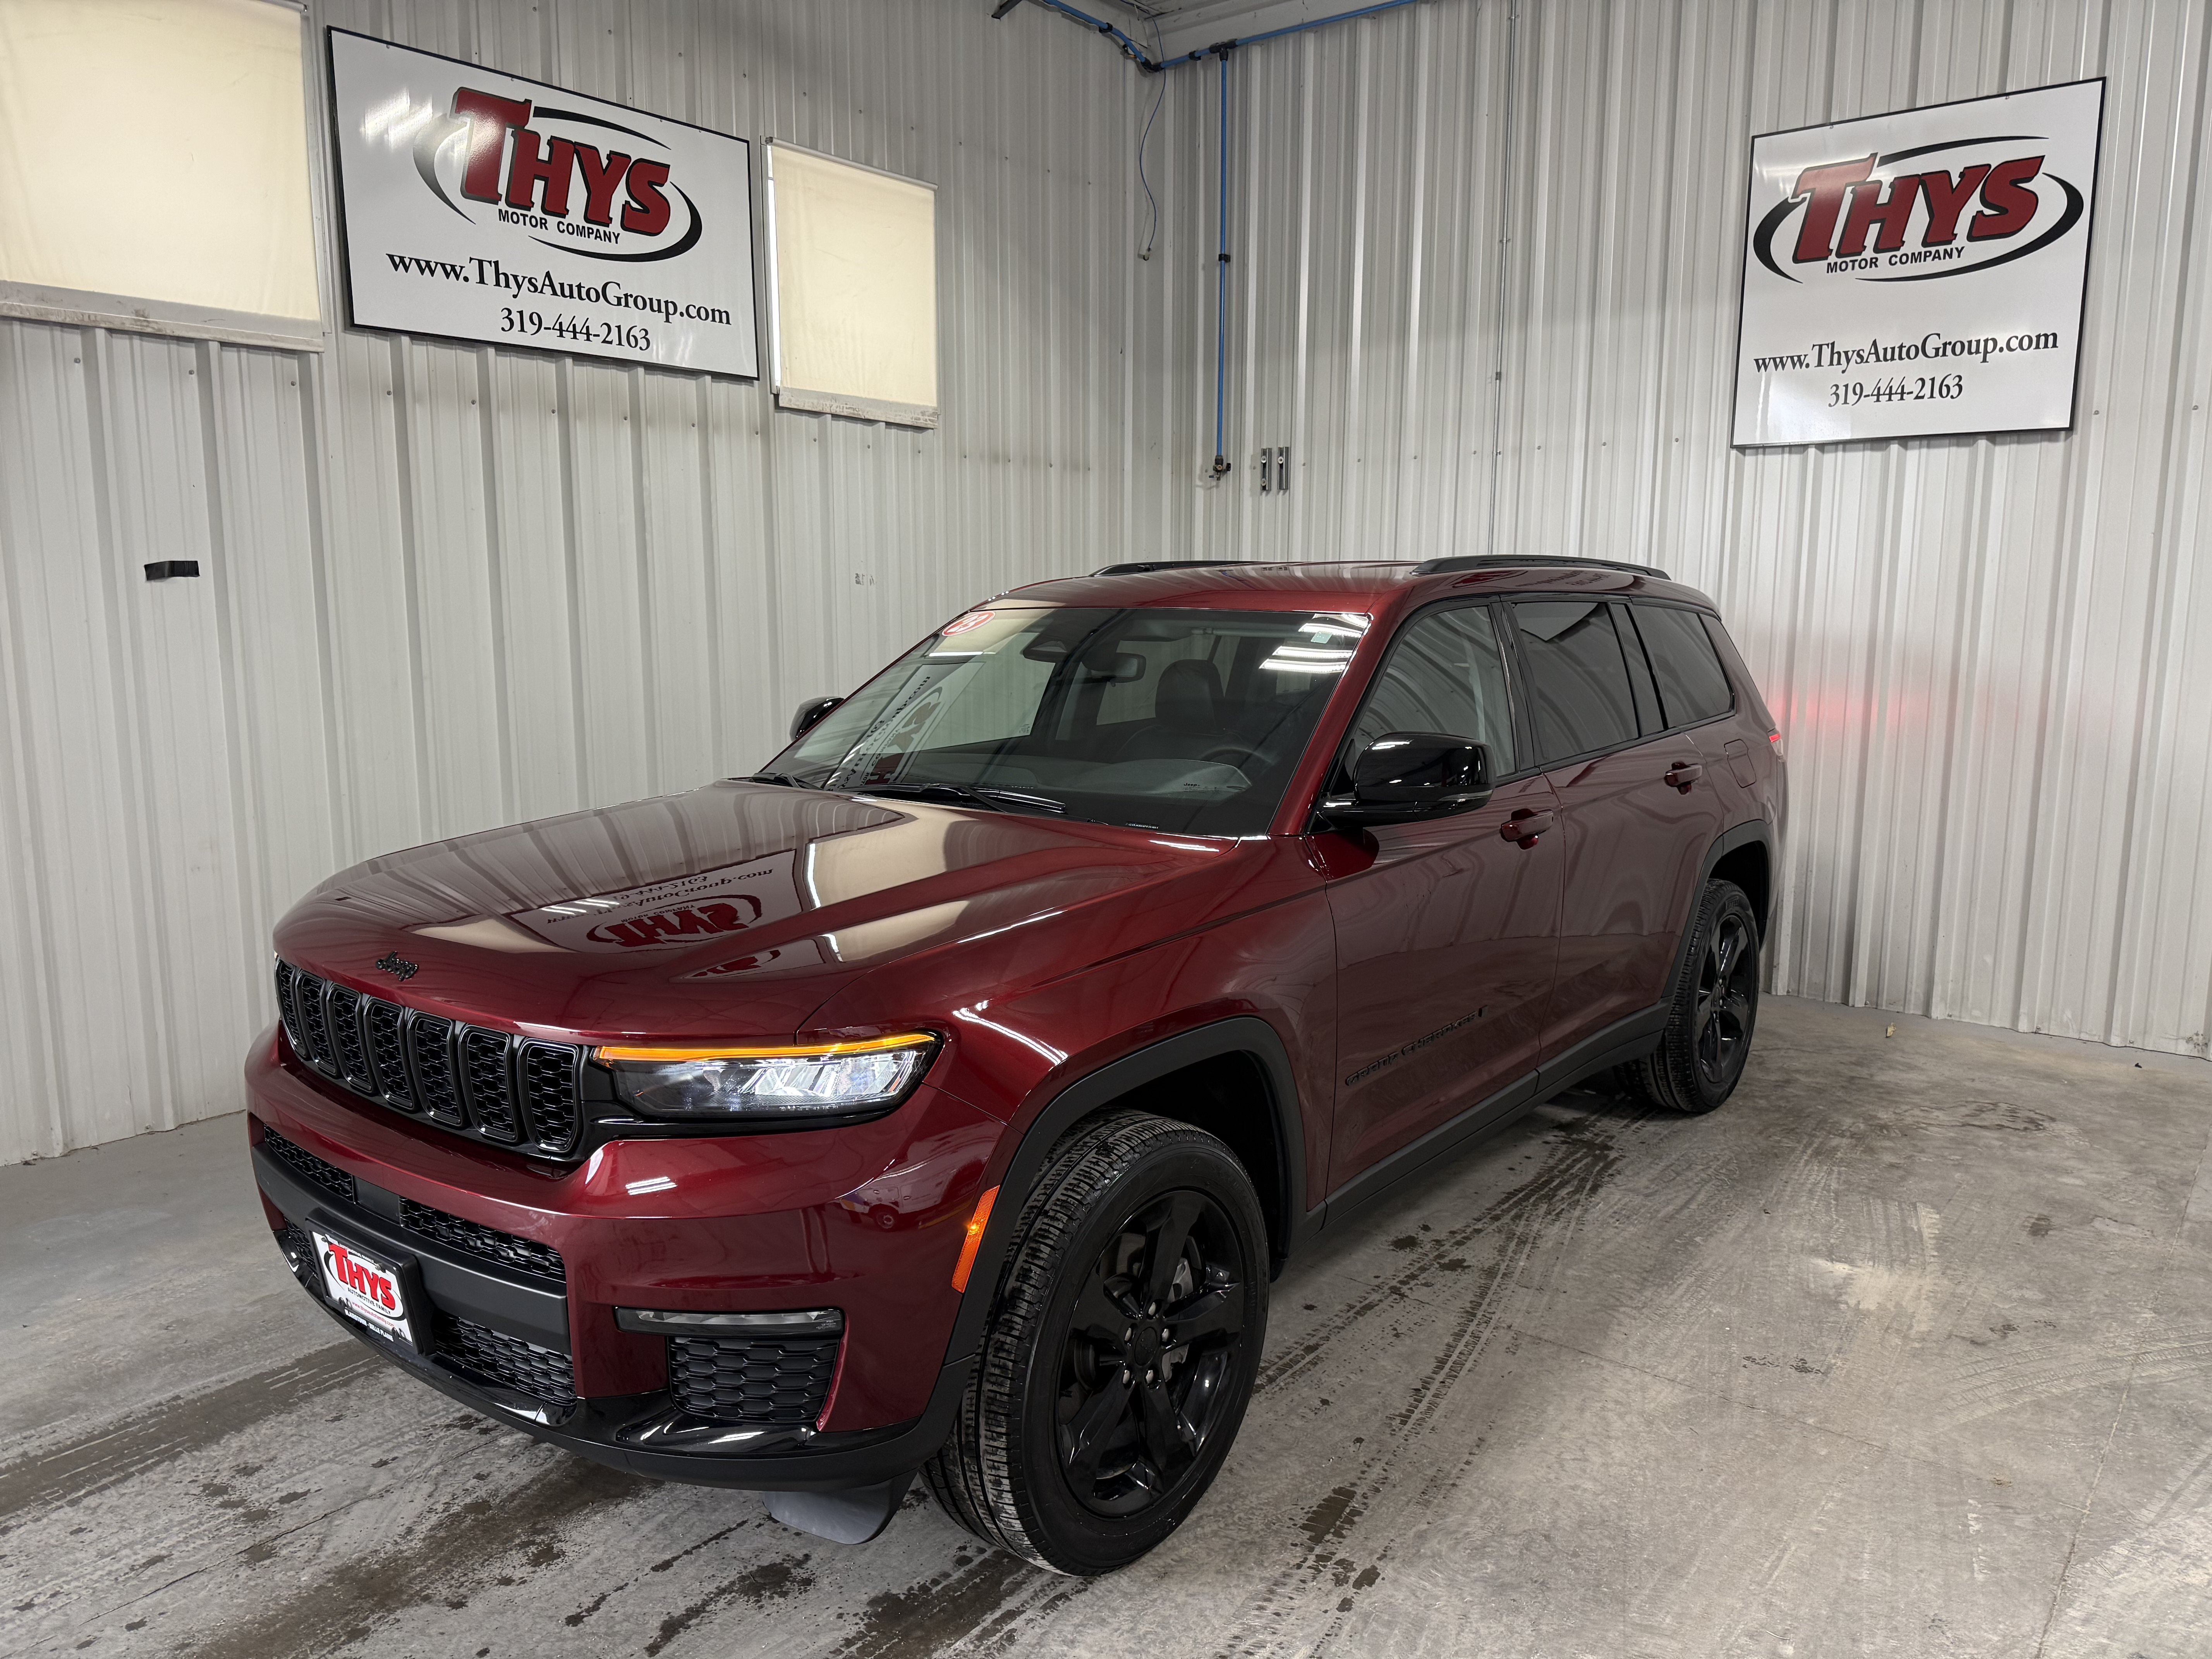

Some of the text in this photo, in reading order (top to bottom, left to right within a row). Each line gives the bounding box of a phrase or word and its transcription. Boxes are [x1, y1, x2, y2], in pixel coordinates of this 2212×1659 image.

[450, 87, 670, 236] THYS
[498, 208, 620, 244] MOTOR COMPANY
[1788, 152, 2045, 264] THYS
[1826, 246, 1965, 273] MOTOR COMPANY
[386, 253, 732, 325] www.ThysAutoGroup.com
[500, 307, 651, 351] 319-444-2163
[1753, 332, 2058, 373] www.ThysAutoGroup.com
[1828, 374, 1963, 407] 319-444-2163
[328, 1242, 395, 1310] THYS
[348, 1288, 391, 1316] AUTOMOTIVE FAMILY
